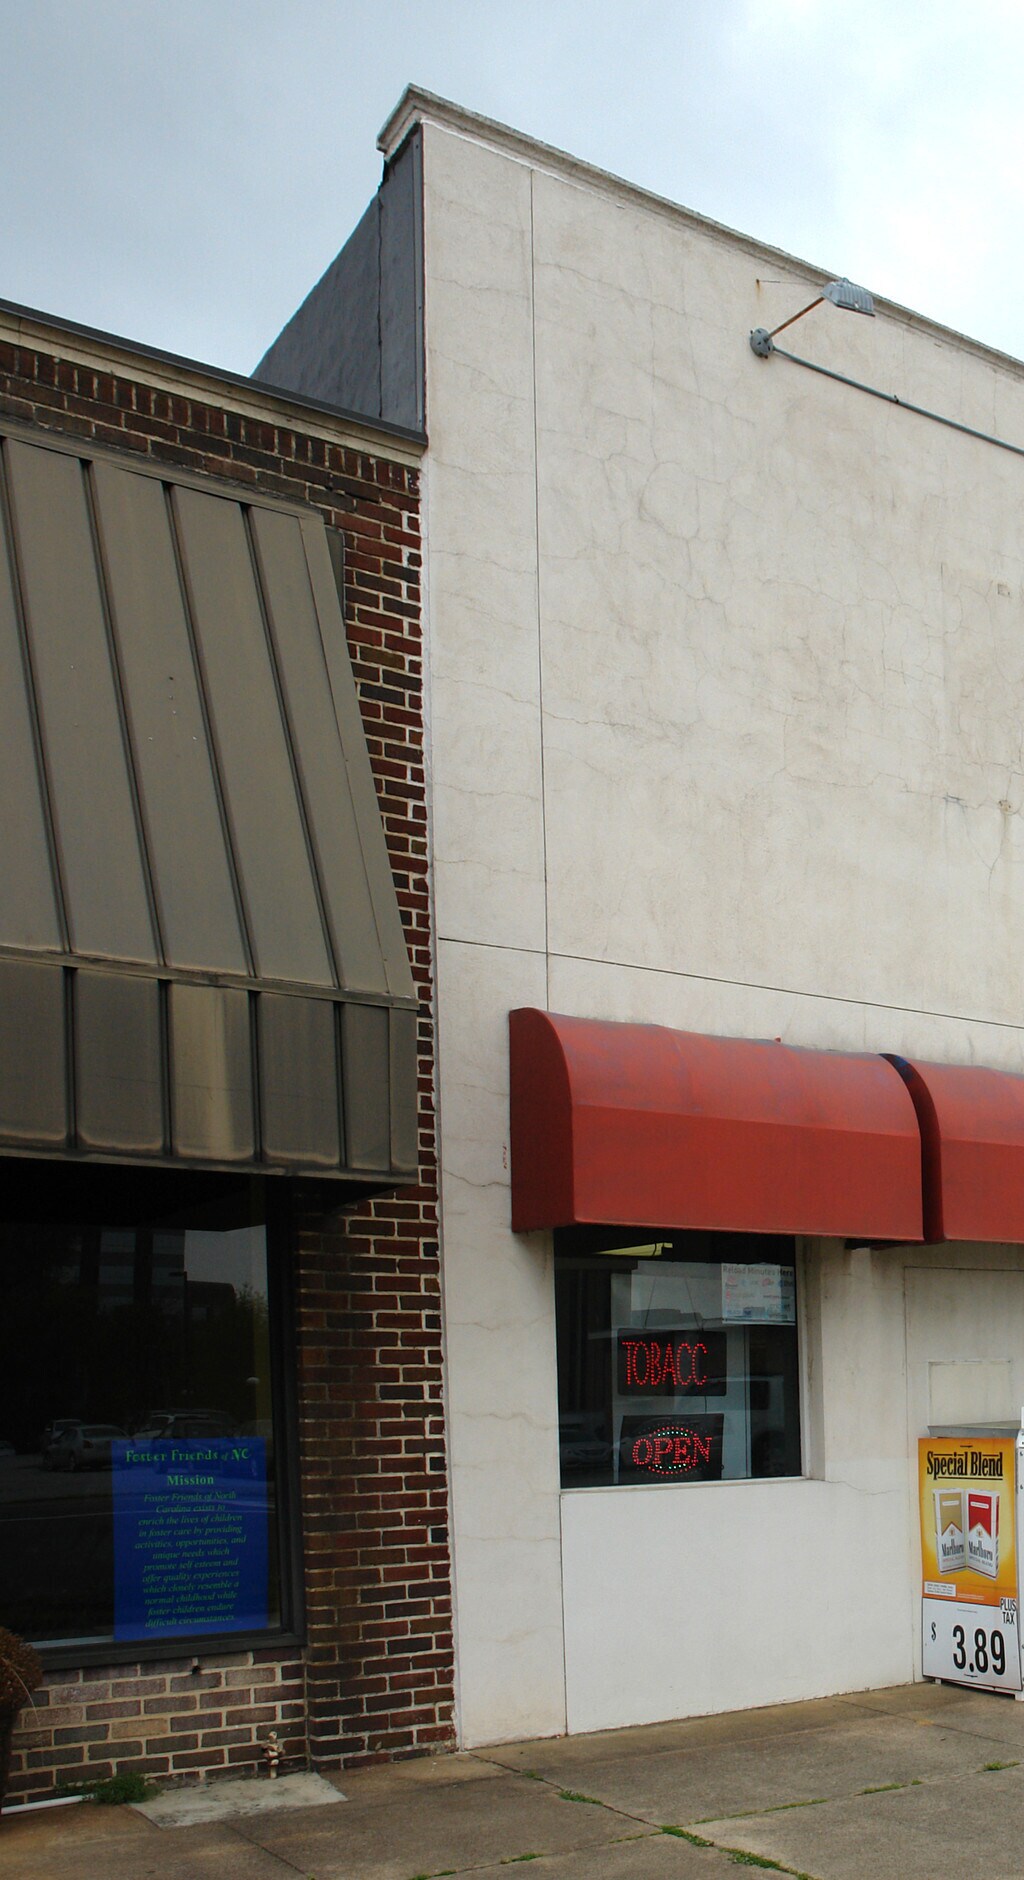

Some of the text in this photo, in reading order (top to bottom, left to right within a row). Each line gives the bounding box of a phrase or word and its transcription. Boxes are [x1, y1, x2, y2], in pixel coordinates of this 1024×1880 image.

[126, 1450, 167, 1463] Foster
[171, 1449, 218, 1462] Friends
[632, 1438, 713, 1465] OPEN
[927, 1451, 1003, 1480] Special Blend
[166, 1474, 214, 1486] Mission
[144, 1493, 169, 1502] Foster
[171, 1492, 202, 1502] Friends
[214, 1491, 237, 1500] North
[156, 1504, 191, 1513] Carolina
[138, 1516, 164, 1526] enrich
[166, 1516, 179, 1525] the
[181, 1515, 199, 1524] lives
[210, 1514, 242, 1522] children
[138, 1525, 242, 1538] in foster care by providing
[230, 1535, 247, 1544] and
[152, 1548, 230, 1561] unique needs which
[143, 1563, 177, 1573] promote
[223, 1557, 239, 1566] and
[142, 1571, 240, 1585] offer quality experiences
[143, 1585, 166, 1594] which
[168, 1583, 195, 1593] closely
[197, 1580, 232, 1590] resemble
[144, 1591, 238, 1605] normal childhood while
[1000, 1598, 1017, 1611] PLUS
[147, 1603, 235, 1618] foster children endure
[145, 1617, 177, 1629] difficult
[1002, 1612, 1015, 1626] TAX
[931, 1622, 1006, 1676] $ 3.89
